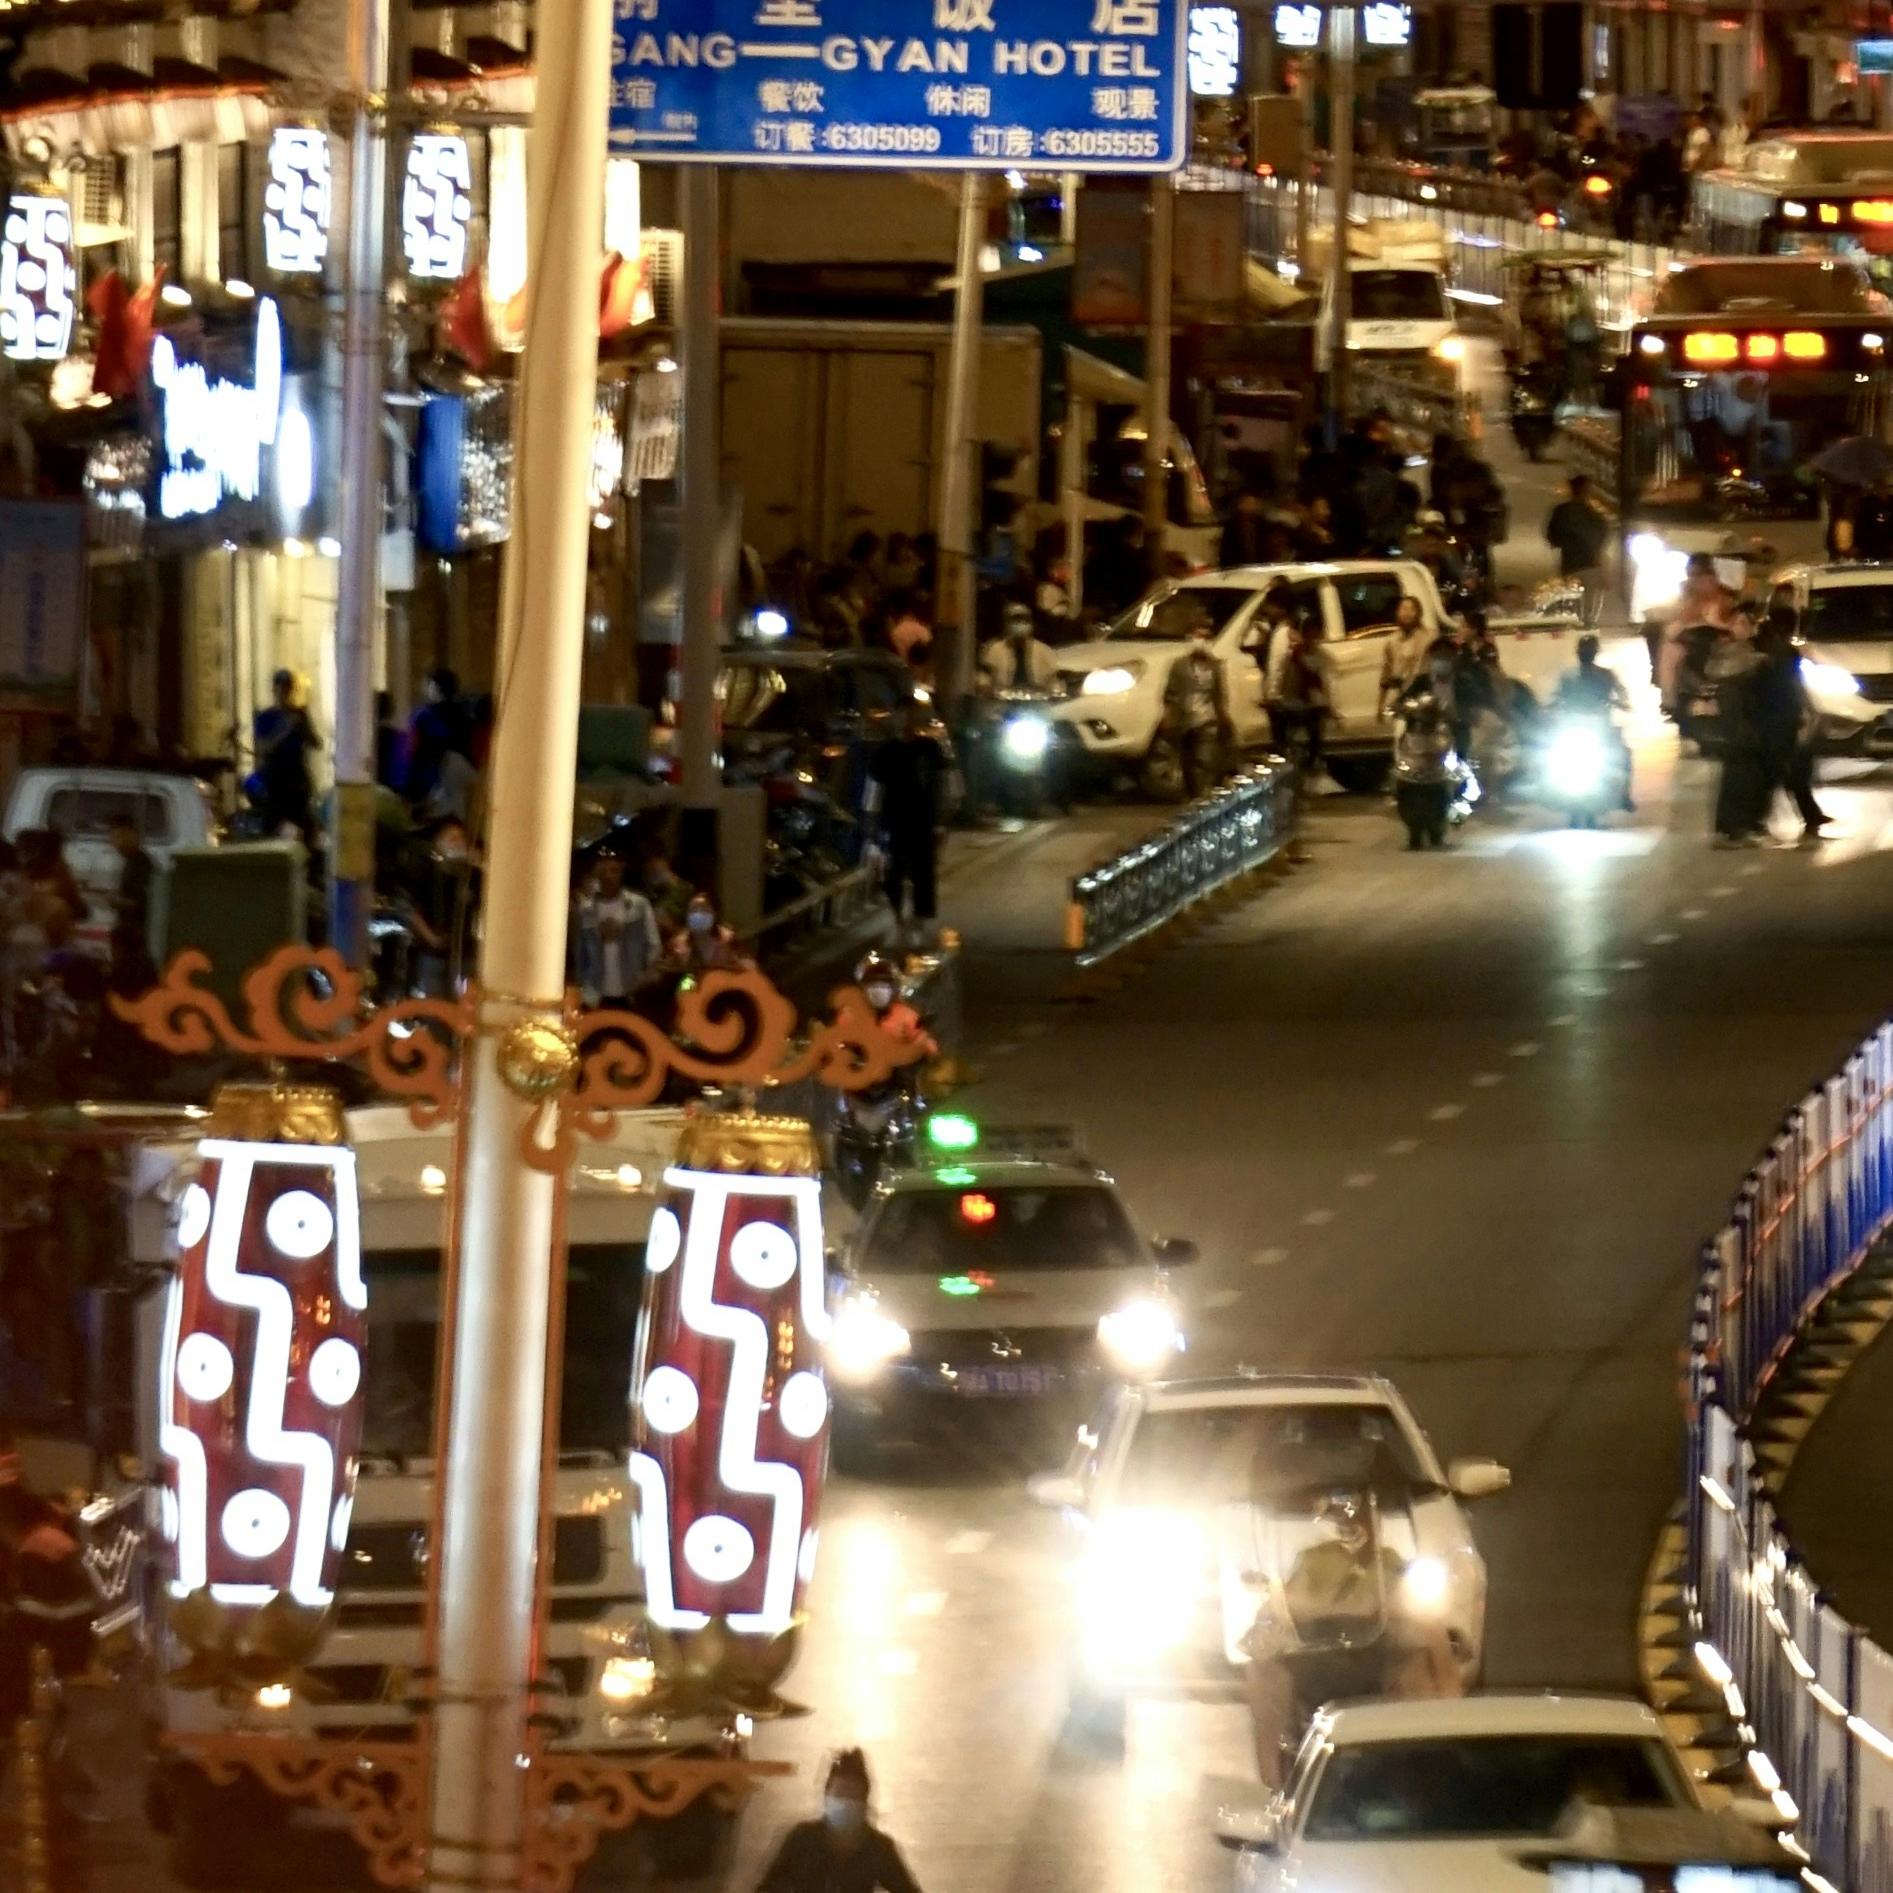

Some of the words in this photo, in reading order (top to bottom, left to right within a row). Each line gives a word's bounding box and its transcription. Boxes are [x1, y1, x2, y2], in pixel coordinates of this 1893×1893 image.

[993, 41, 1161, 77] HOTEL
[757, 79, 824, 113] 餐饮
[925, 83, 991, 117] 休闲
[1090, 87, 1160, 120] 观景
